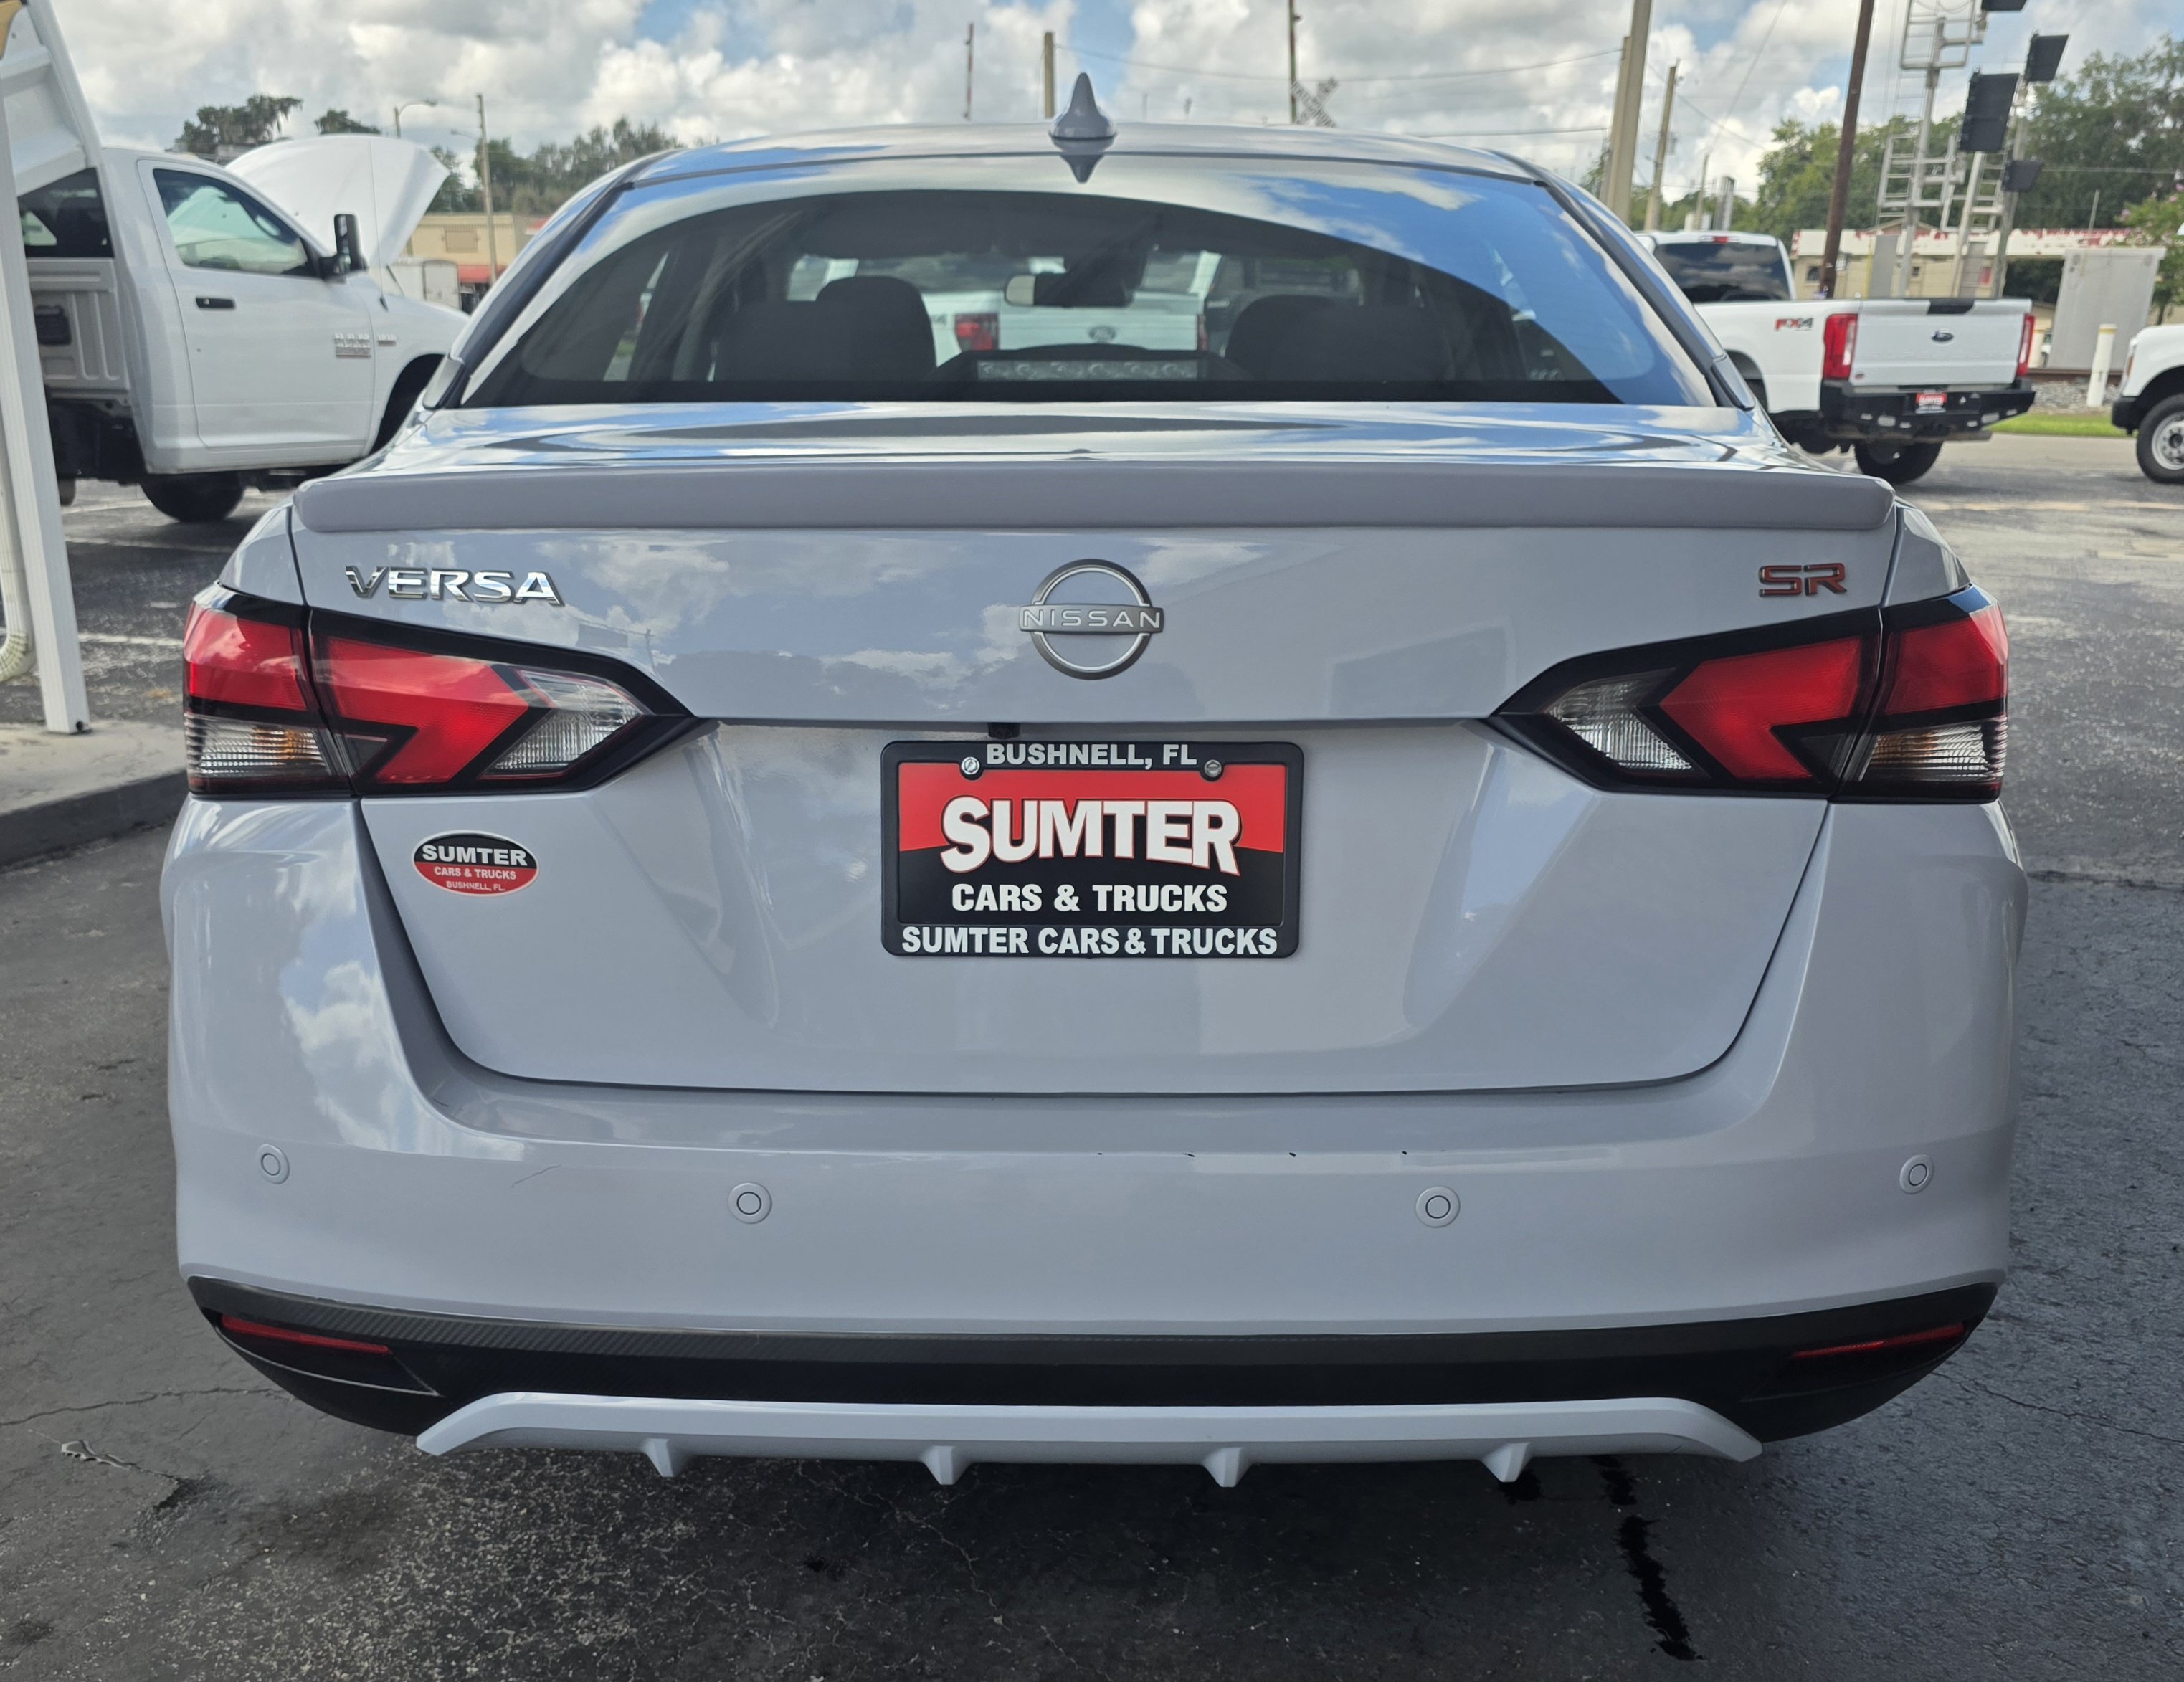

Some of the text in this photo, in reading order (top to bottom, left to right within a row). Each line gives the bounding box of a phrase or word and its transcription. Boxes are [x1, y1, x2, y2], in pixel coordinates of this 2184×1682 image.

[346, 565, 565, 606] VERSA
[1759, 562, 1848, 597] SR
[1023, 609, 1161, 628] NISSAN
[987, 743, 1197, 770] BUSHNELL, FL
[940, 795, 1241, 876] SUMTER
[422, 845, 528, 866] SUMTER
[435, 867, 516, 880] CARS & TRUCKS
[446, 881, 492, 891] BUSHNELL,
[951, 883, 1228, 913] CARS & TRUCKS
[902, 926, 1278, 955] SUMTER CARS & TRUCKS
